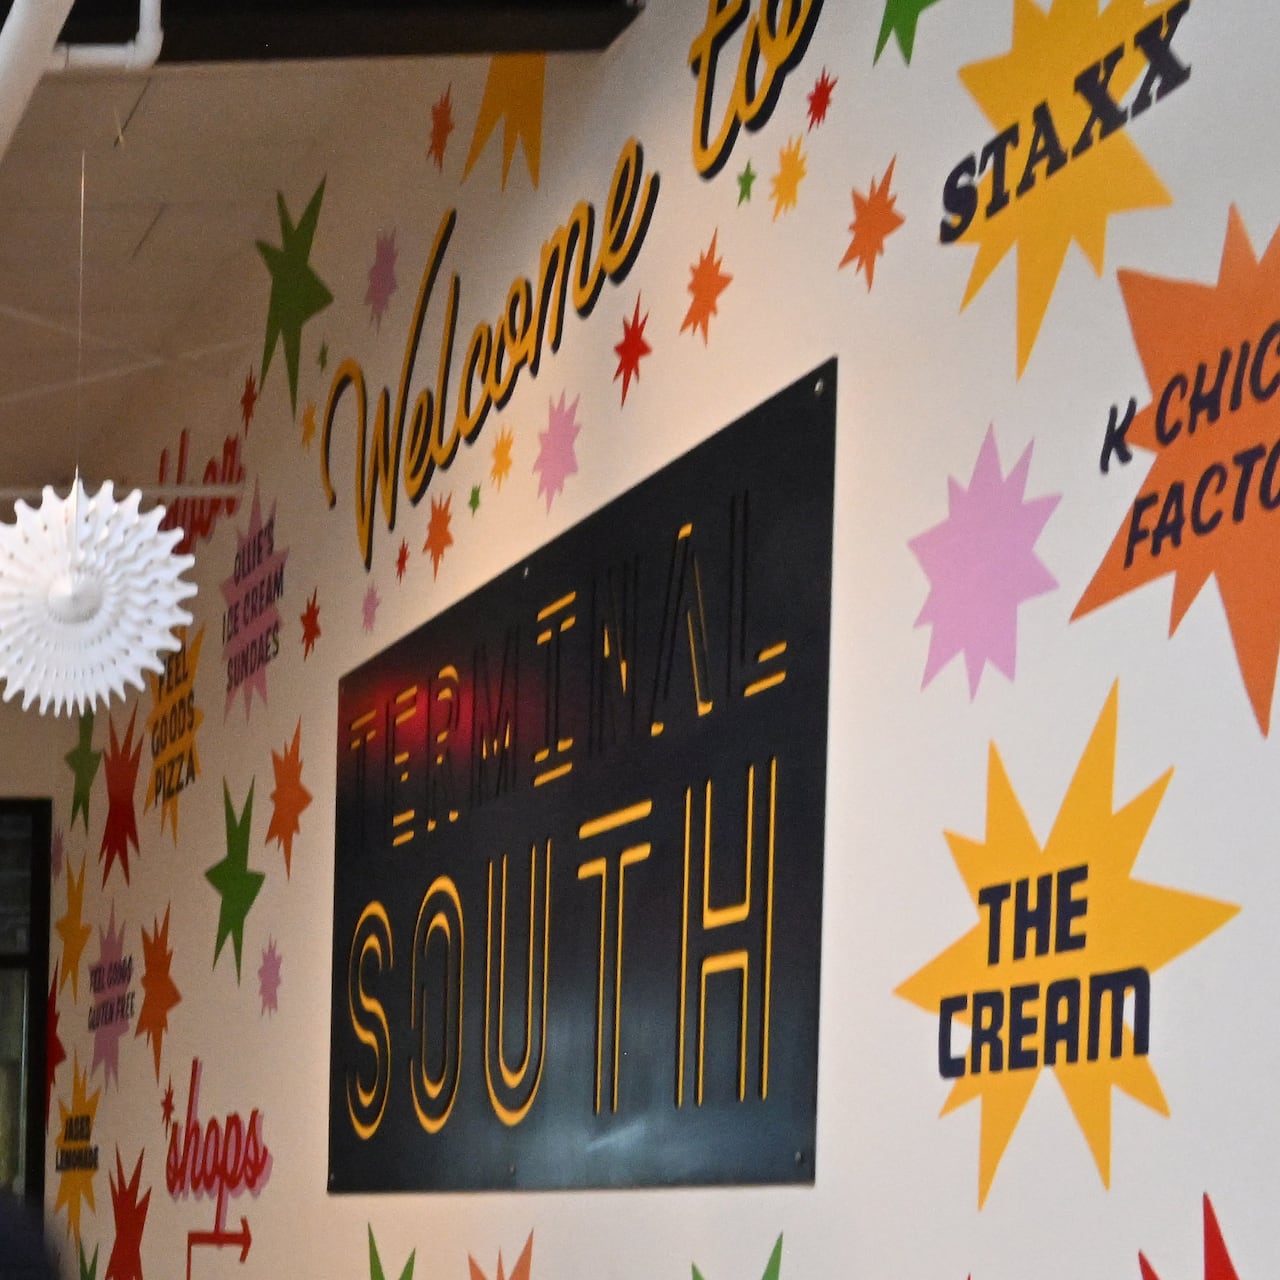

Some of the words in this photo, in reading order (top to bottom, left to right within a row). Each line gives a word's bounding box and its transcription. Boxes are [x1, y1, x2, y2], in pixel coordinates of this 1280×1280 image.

[939, 0, 1192, 246] STAXX
[320, 136, 660, 571] Welcome
[1099, 396, 1137, 475] K
[243, 562, 284, 627] CREAM
[226, 620, 279, 693] SUNDAES
[349, 488, 788, 848] TERMINAL
[154, 747, 195, 808] PIZZA
[345, 756, 777, 1141] SOUTH
[978, 862, 1089, 967] THE
[938, 966, 1150, 1079] CREAM
[165, 1056, 274, 1235] shops
